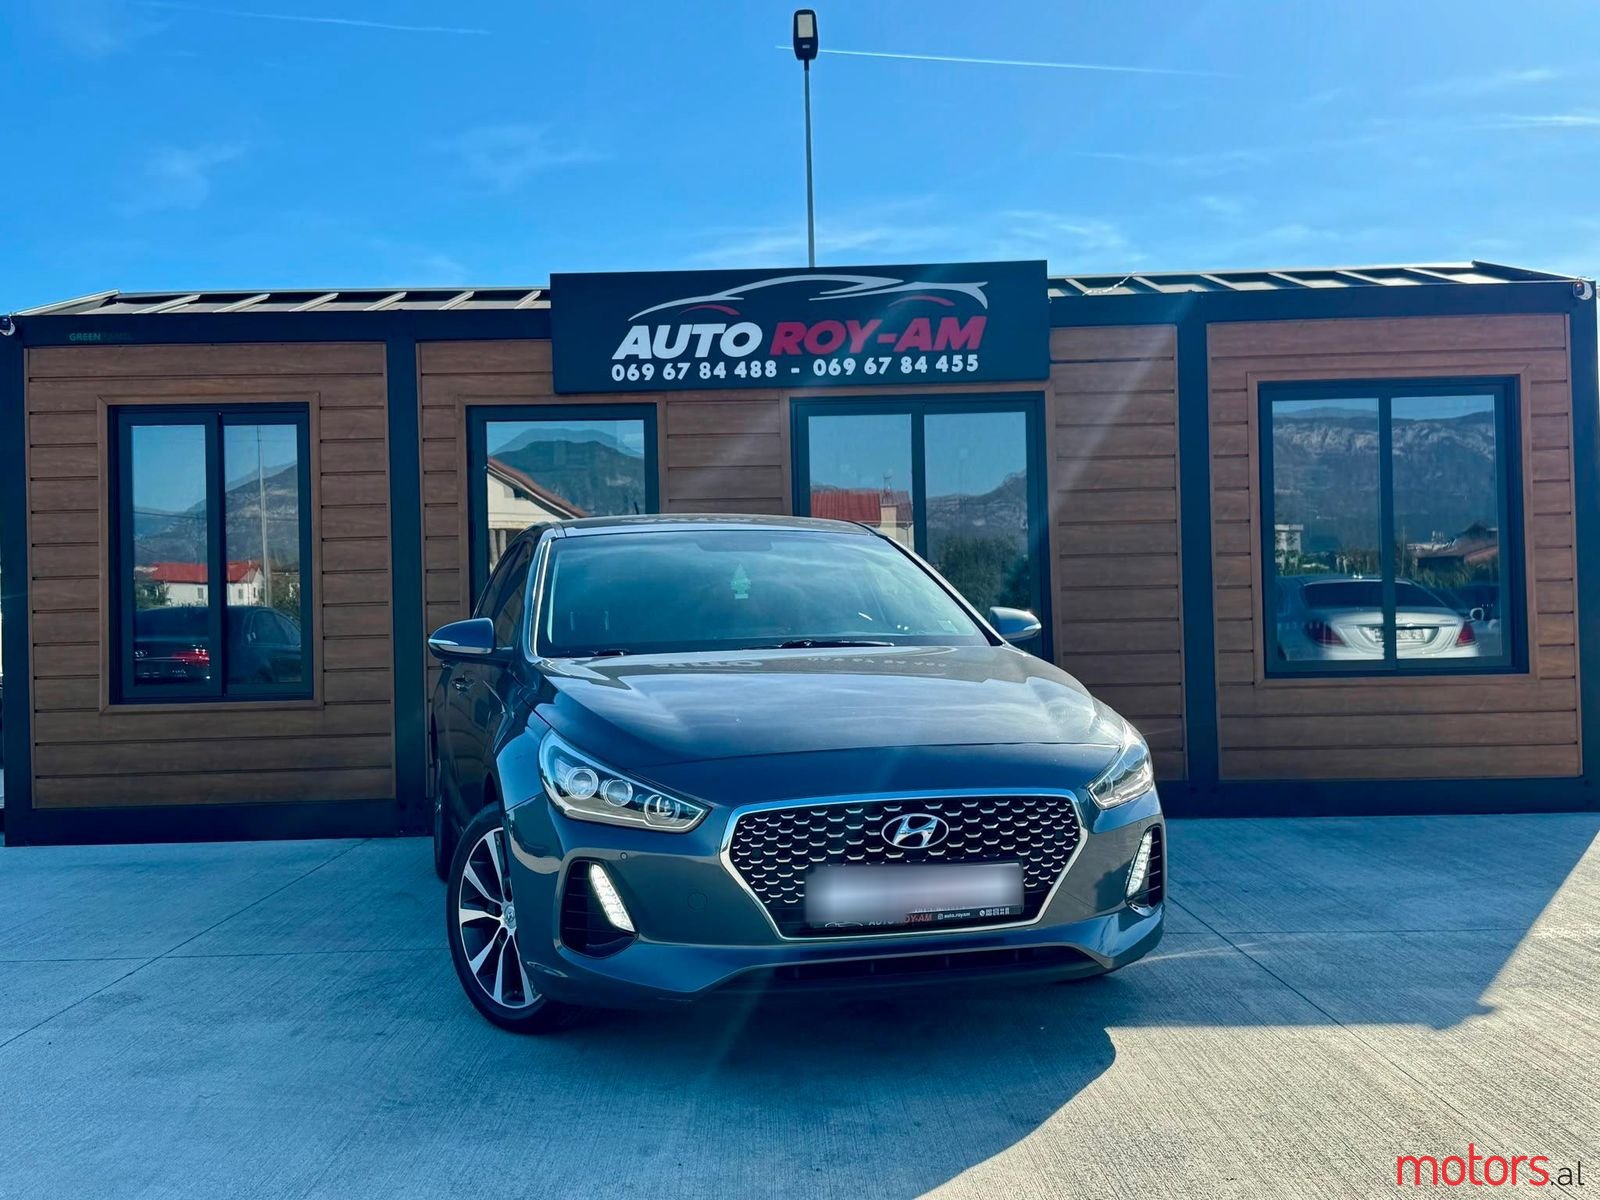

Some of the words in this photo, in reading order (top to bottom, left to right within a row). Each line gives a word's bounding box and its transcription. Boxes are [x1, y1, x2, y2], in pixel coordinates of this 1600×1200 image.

[69, 332, 101, 342] GREEN
[611, 322, 763, 360] AUTO
[769, 316, 987, 356] ROY-AM
[611, 363, 655, 382] 069
[662, 363, 691, 380] 67
[699, 361, 727, 379] 84
[734, 360, 777, 378] 488
[813, 358, 857, 376] 069
[864, 357, 892, 375] 67
[900, 356, 928, 374] 84
[935, 354, 979, 373] 455
